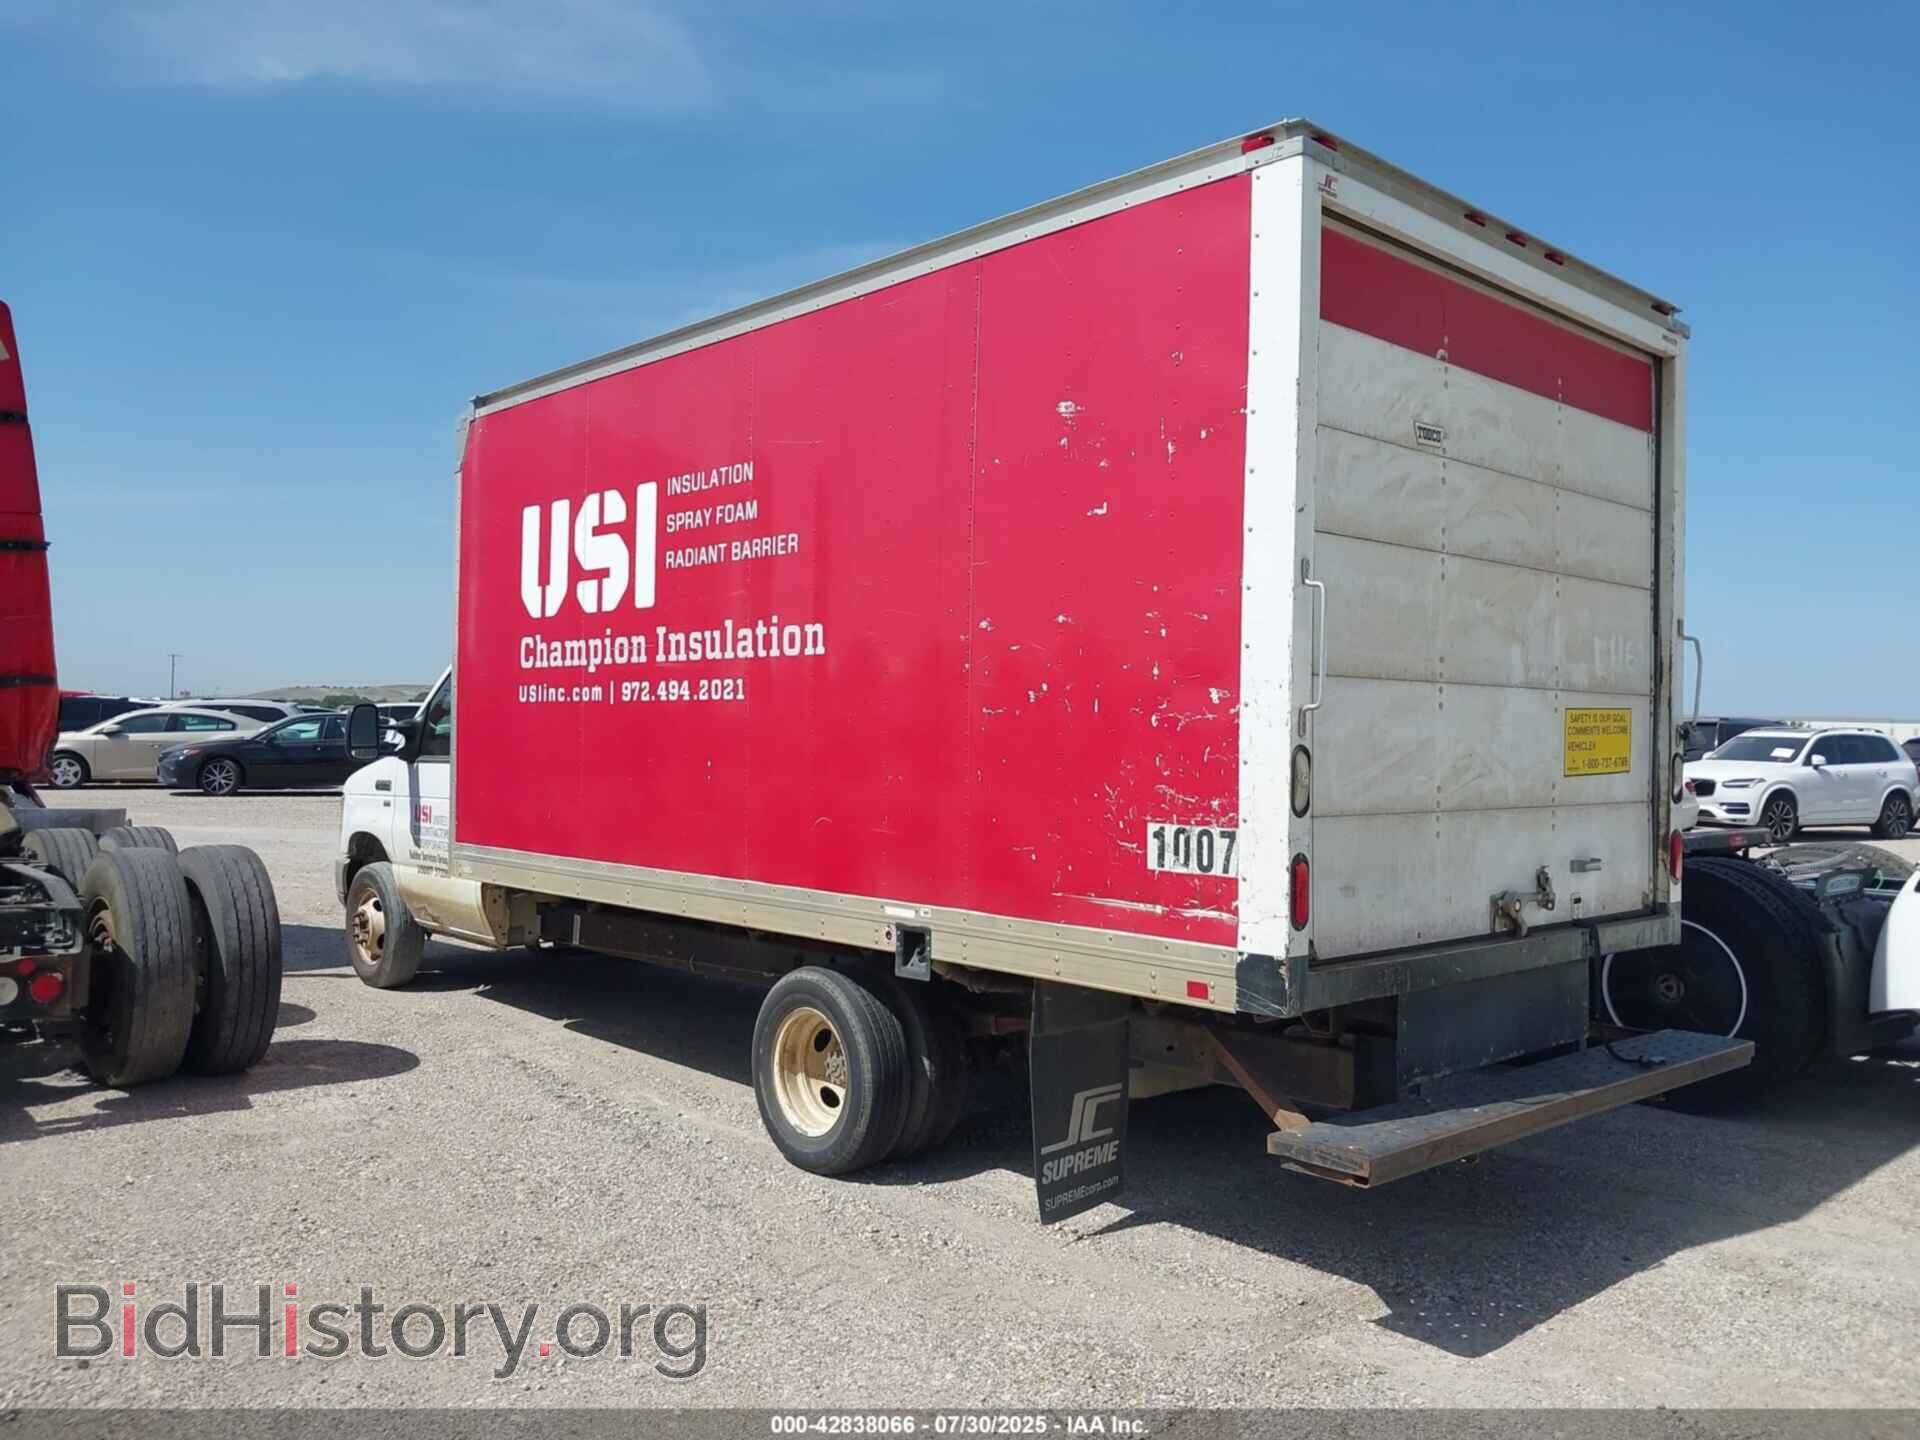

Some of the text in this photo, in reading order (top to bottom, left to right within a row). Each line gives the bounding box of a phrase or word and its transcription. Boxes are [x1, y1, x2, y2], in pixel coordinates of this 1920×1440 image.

[667, 461, 754, 496] INSULATION
[666, 500, 758, 533] SPRAY FOAM
[521, 481, 657, 618] USI
[665, 533, 799, 569] RADIANT BARRIER
[520, 615, 826, 673] Champion Insulation
[518, 683, 603, 703] USIinc.com
[621, 678, 745, 702] 972.494.2021
[1569, 712, 1591, 723] SAFETY
[1152, 826, 1238, 874] 1007
[1042, 1140, 1120, 1185] SUPREME
[1045, 1175, 1120, 1212] SUPREMEcorp.com
